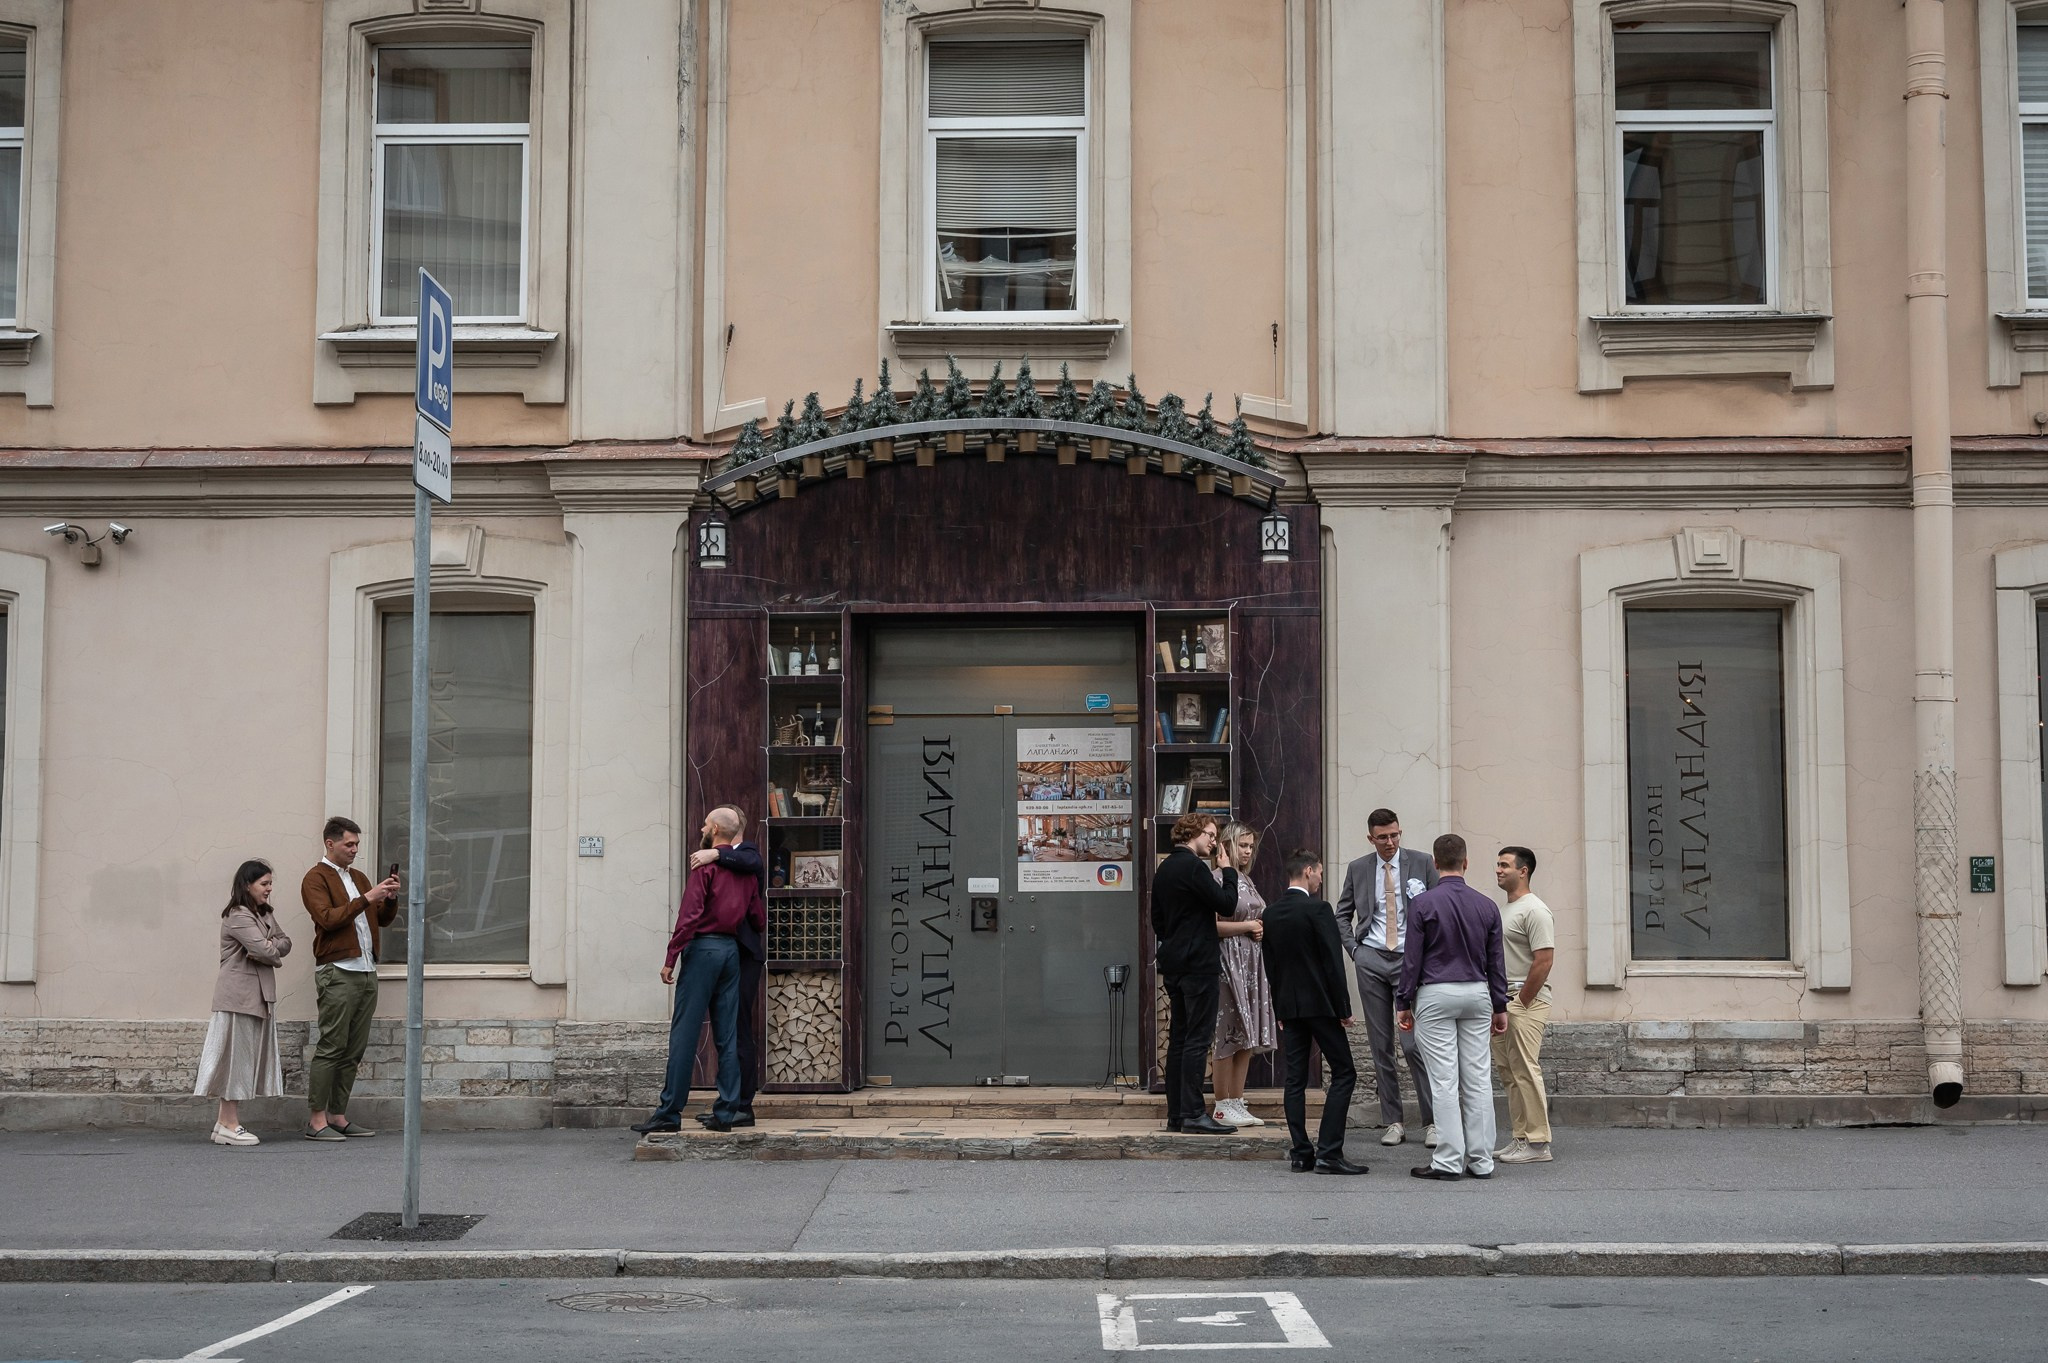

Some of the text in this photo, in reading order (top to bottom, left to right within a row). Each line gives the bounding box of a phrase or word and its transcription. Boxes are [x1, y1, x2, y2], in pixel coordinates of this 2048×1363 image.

[428, 295, 447, 401] P
[418, 440, 448, 480] 8.00-20.00
[1026, 748, 1078, 756] ЛАПЛАНДИЯ
[1675, 660, 1710, 940] ЛАПЛАНДИЯ
[917, 734, 957, 1060] ЛАПЛАНДИЯ
